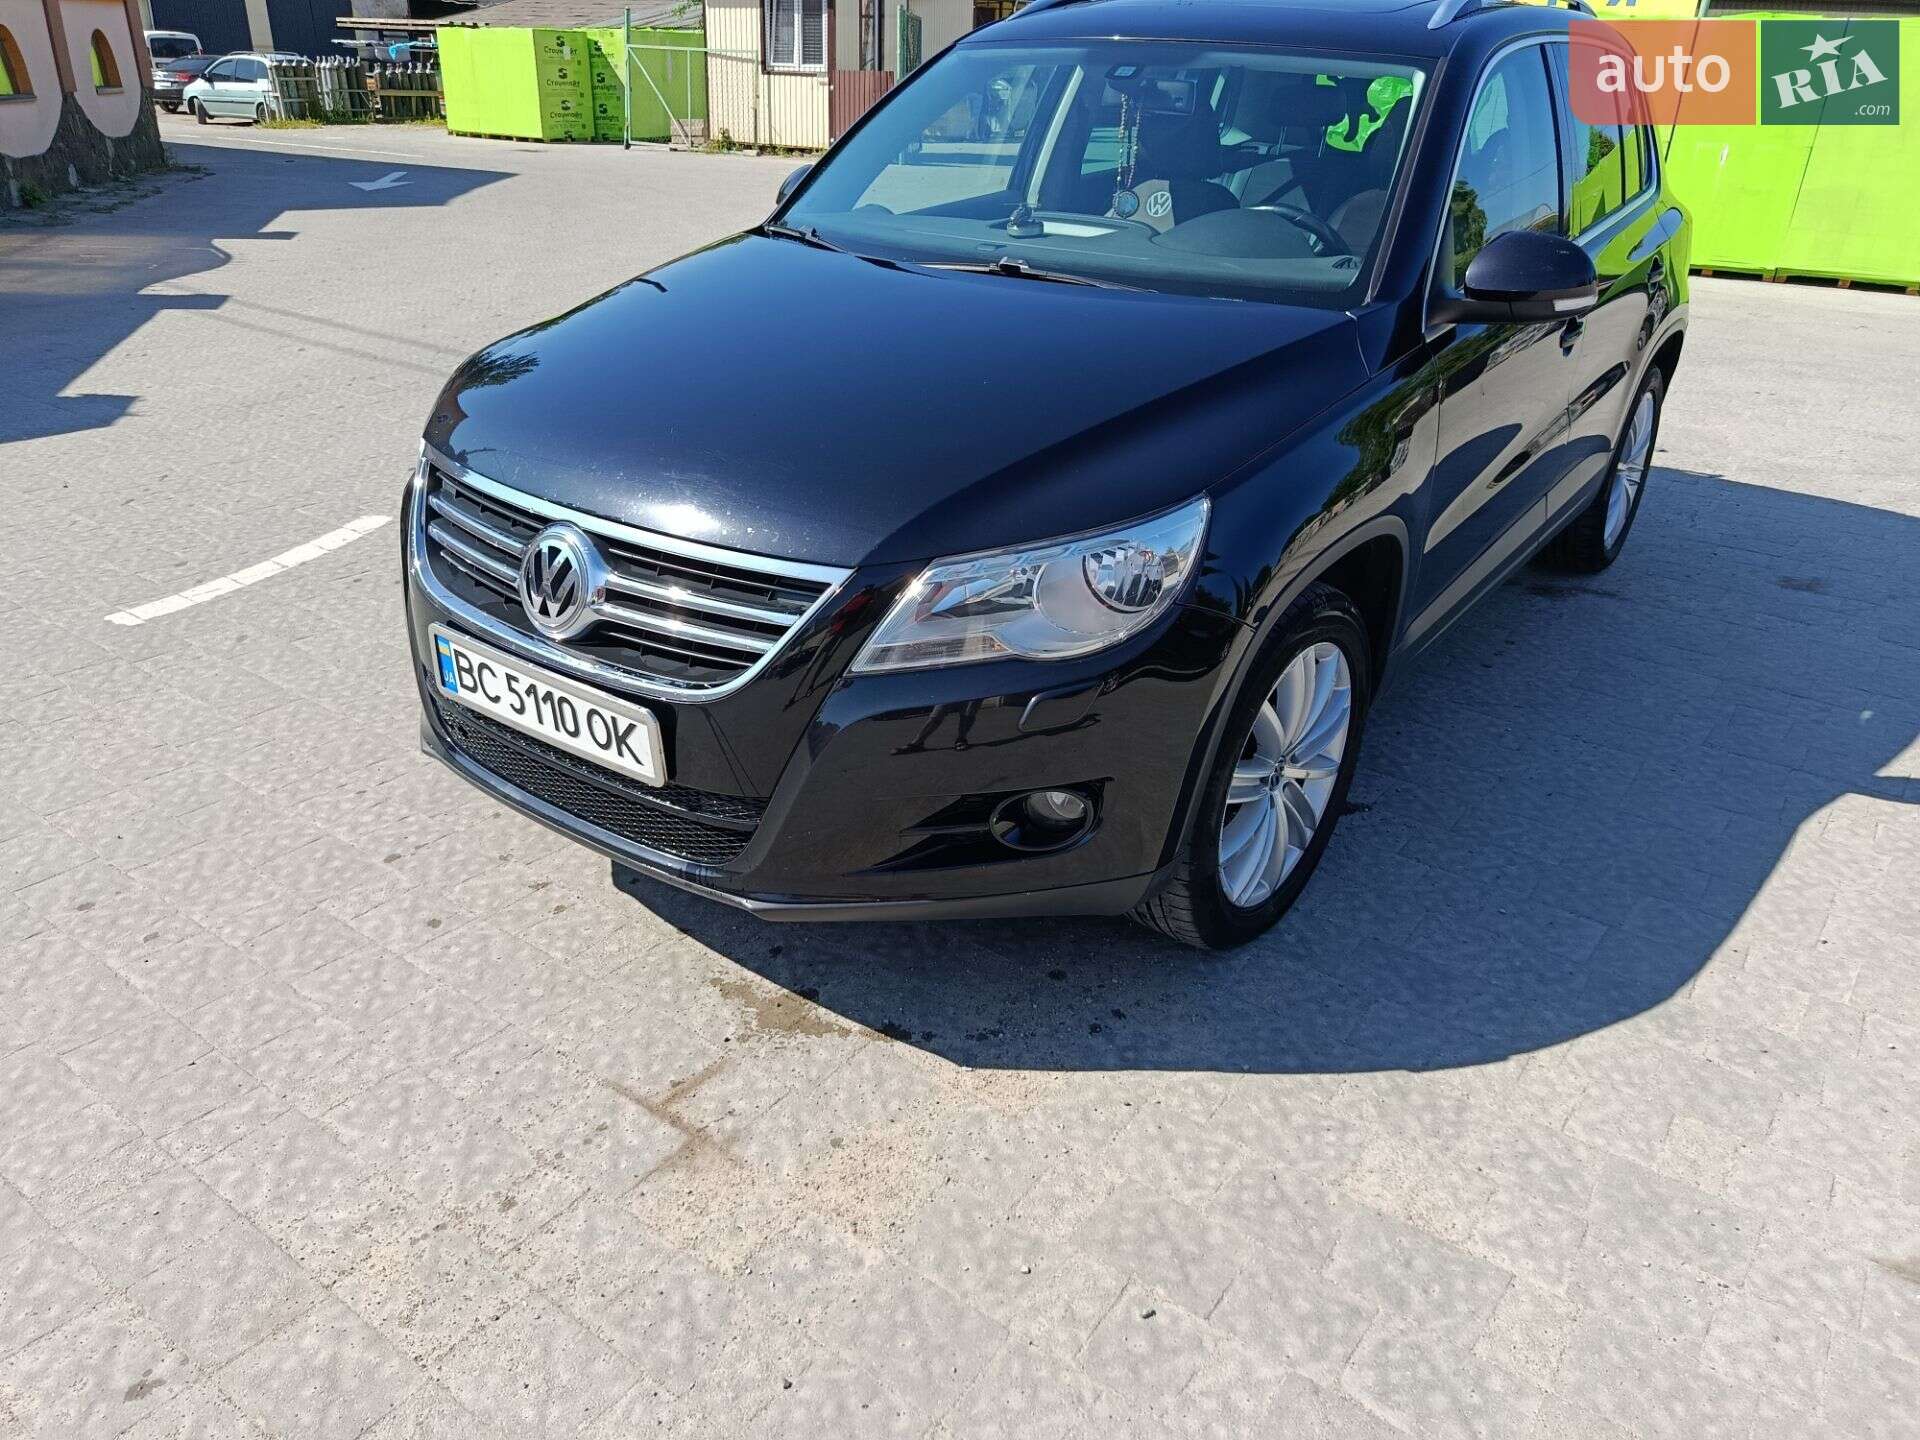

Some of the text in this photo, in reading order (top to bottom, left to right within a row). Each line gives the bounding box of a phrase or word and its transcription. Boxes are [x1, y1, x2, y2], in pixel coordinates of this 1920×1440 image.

[453, 648, 644, 766] BC 5110 OK
